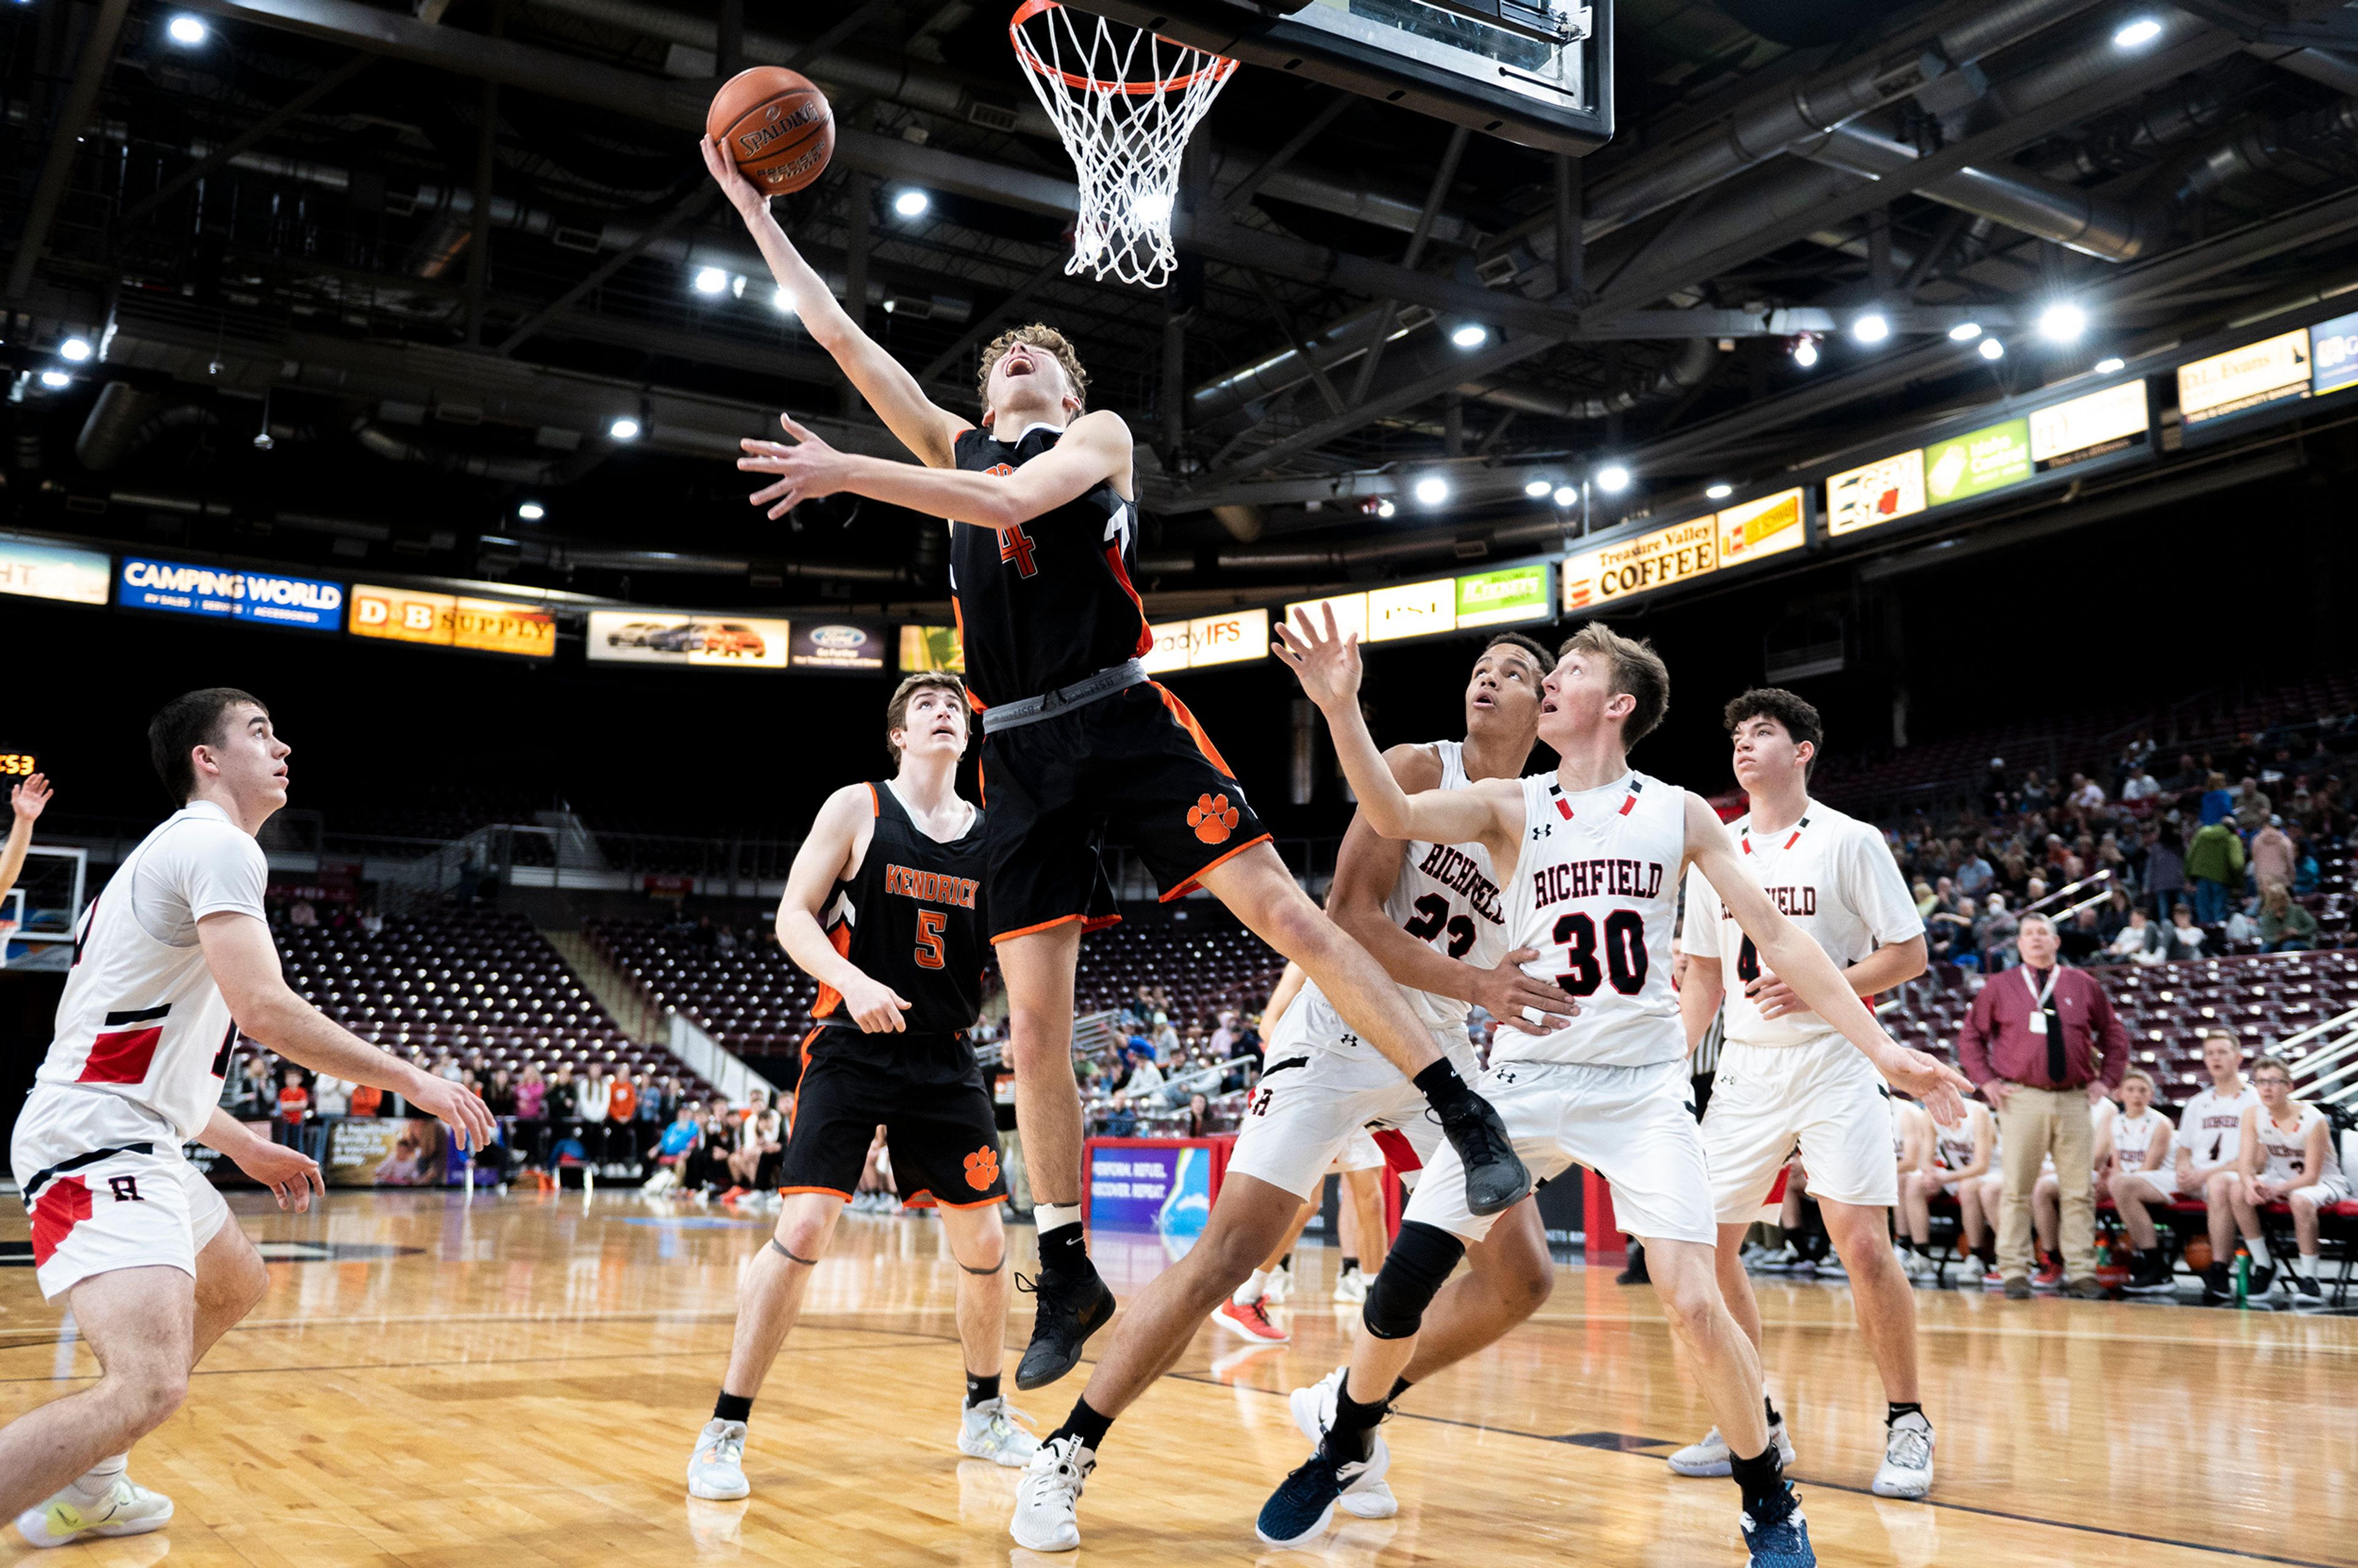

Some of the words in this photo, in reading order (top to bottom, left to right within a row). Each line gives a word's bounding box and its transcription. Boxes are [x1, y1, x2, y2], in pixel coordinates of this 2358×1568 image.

[739, 100, 820, 157] SPALDING
[996, 523, 1038, 579] 4
[1599, 539, 1662, 567] Treasure
[1665, 525, 1711, 547] Valley
[1600, 541, 1714, 596] COFFEE
[124, 562, 246, 599] CAMPING
[247, 576, 343, 610] WORLD
[441, 611, 548, 640] SUPPLY
[1154, 621, 1240, 655] radyIFS
[885, 863, 981, 910] KENDRICK
[1533, 858, 1663, 910] RICHFIELD
[914, 909, 948, 969] 5
[1552, 909, 1649, 998] 30
[109, 1175, 144, 1202] R
